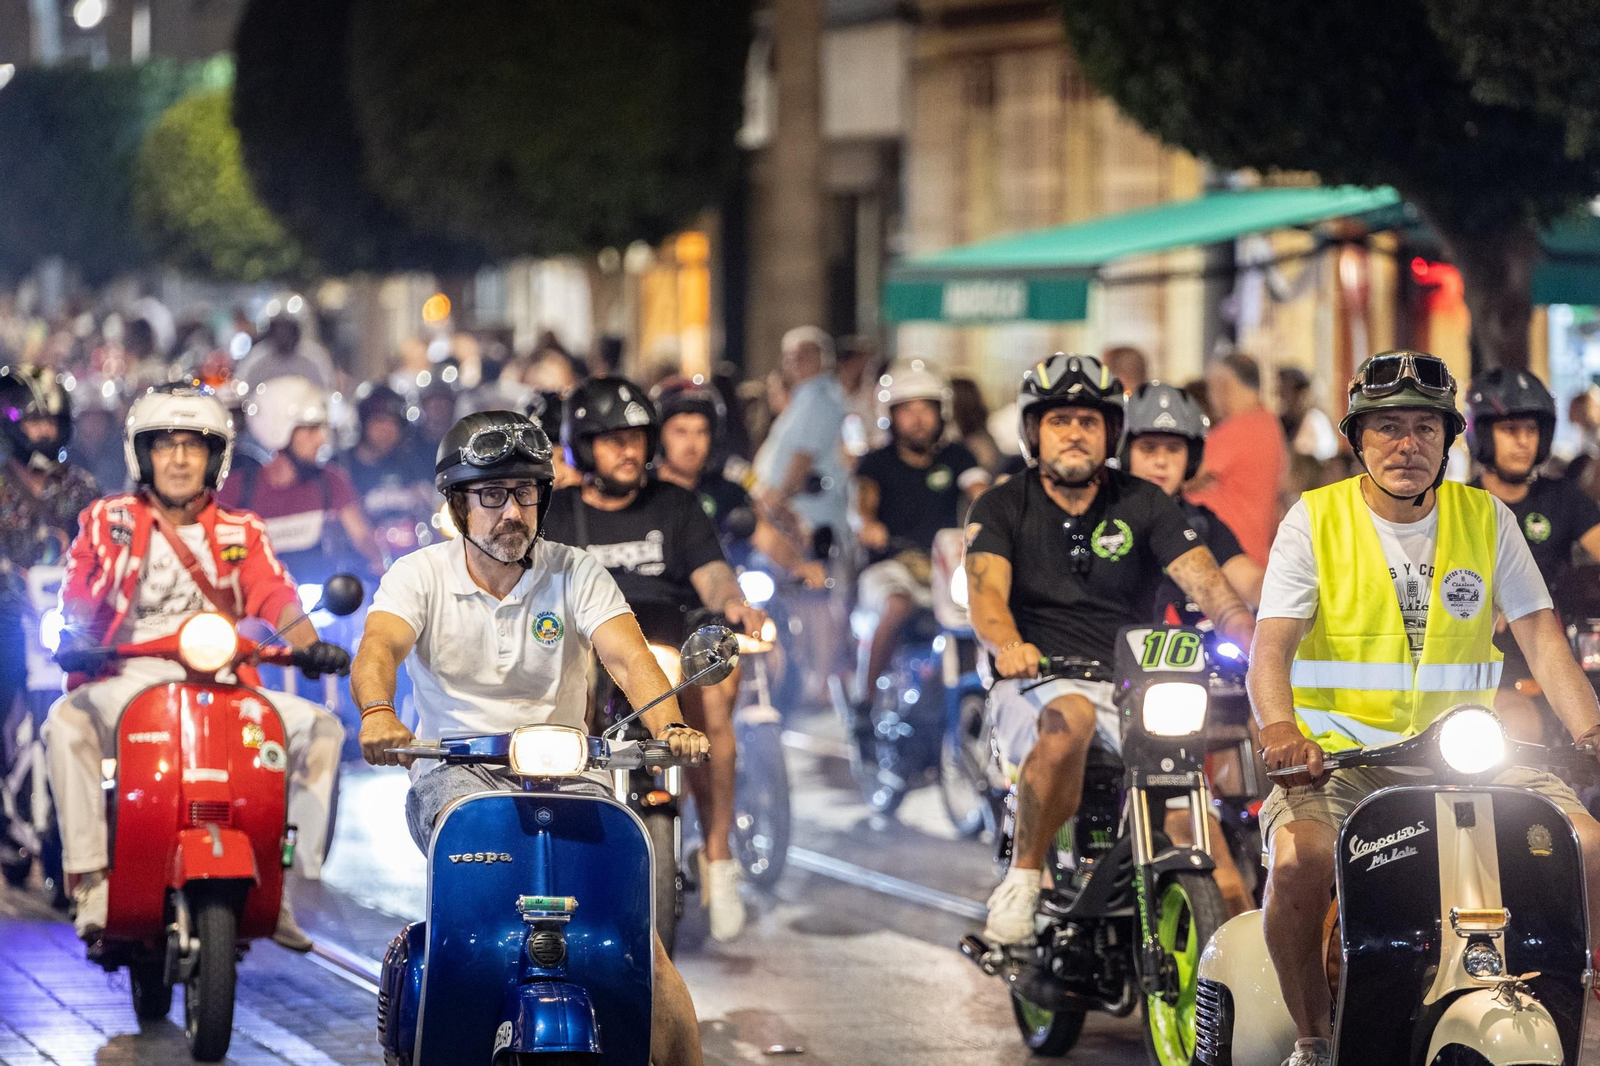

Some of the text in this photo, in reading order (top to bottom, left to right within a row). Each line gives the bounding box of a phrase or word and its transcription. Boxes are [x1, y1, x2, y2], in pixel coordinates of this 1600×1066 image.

[1404, 563, 1411, 575] Y
[1444, 570, 1458, 584] MOTOS
[1465, 570, 1482, 583] COCHES
[1142, 631, 1200, 667] 16
[1349, 834, 1395, 863] Vespa
[448, 852, 513, 865] vespa
